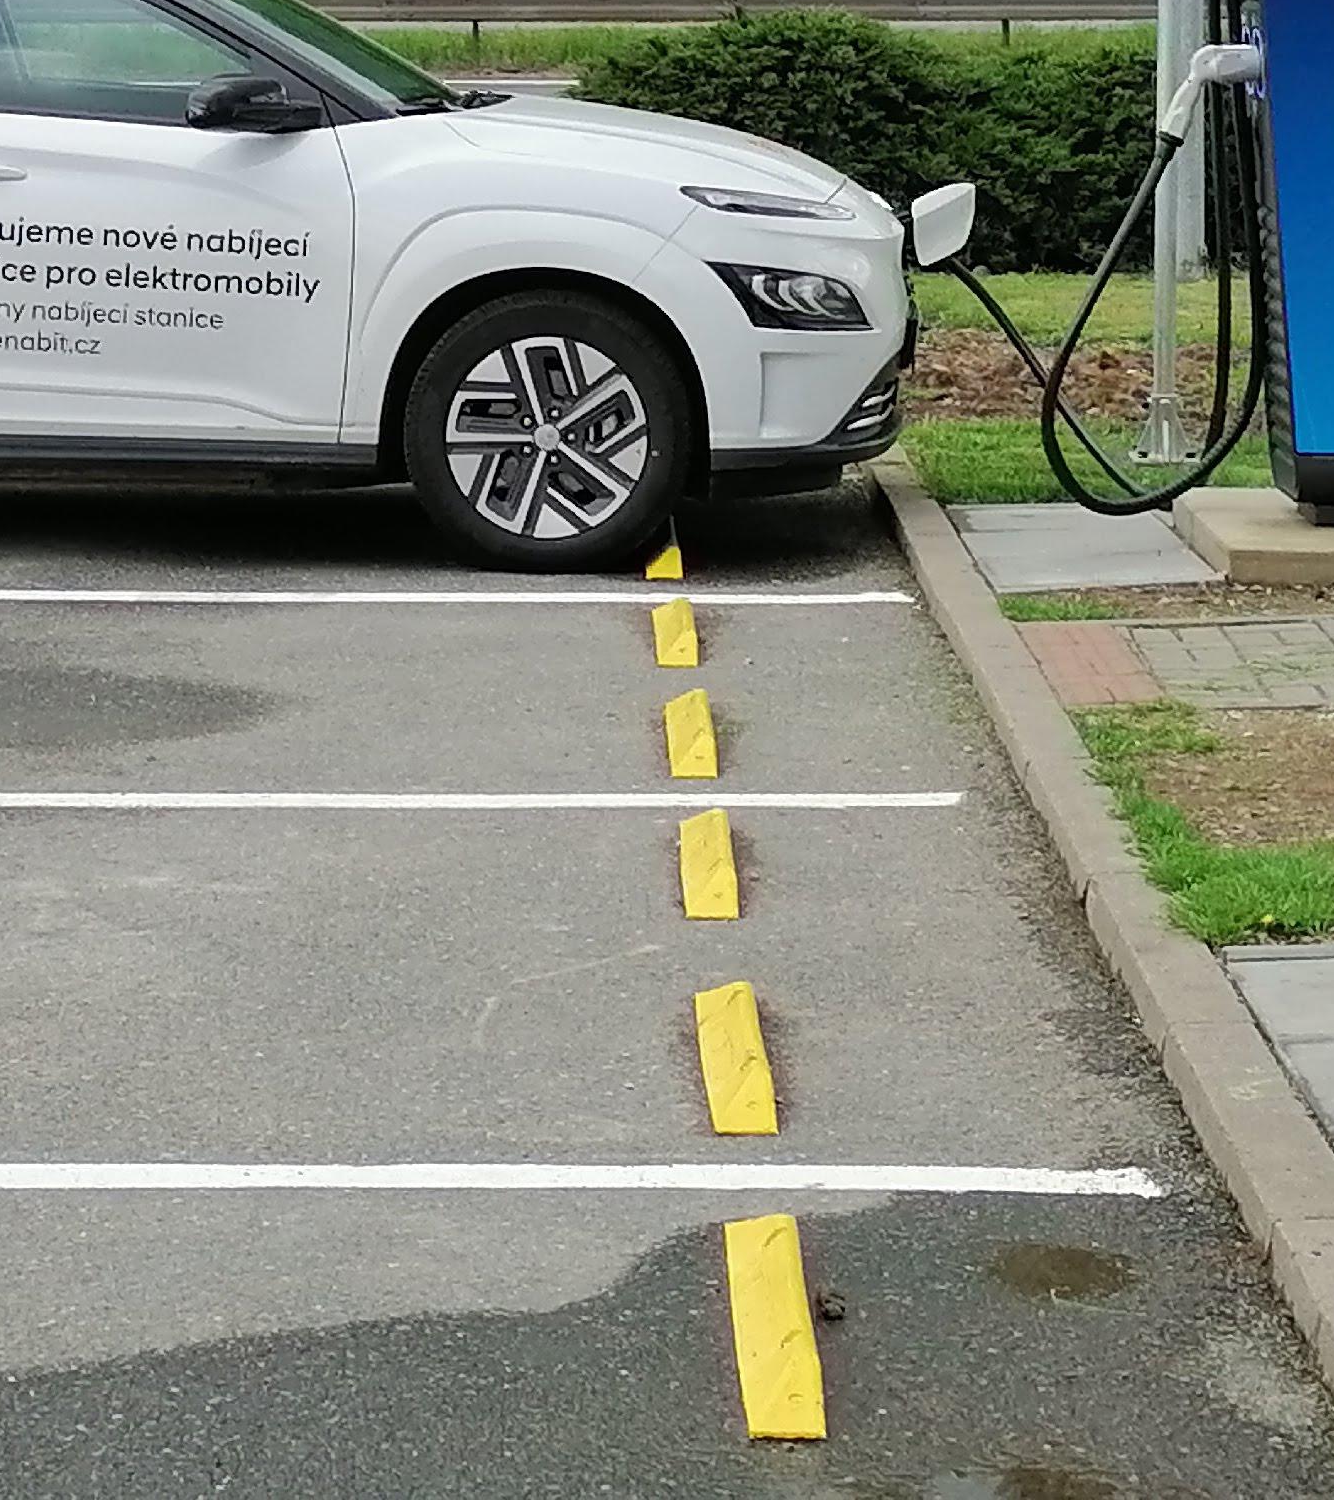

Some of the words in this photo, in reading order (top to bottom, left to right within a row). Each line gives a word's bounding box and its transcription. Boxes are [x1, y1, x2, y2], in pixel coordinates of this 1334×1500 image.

[102, 223, 179, 251] nové
[186, 228, 312, 261] nabíjecí
[45, 265, 97, 290] pro
[105, 262, 321, 304] elektromobily
[134, 307, 225, 330] stanice
